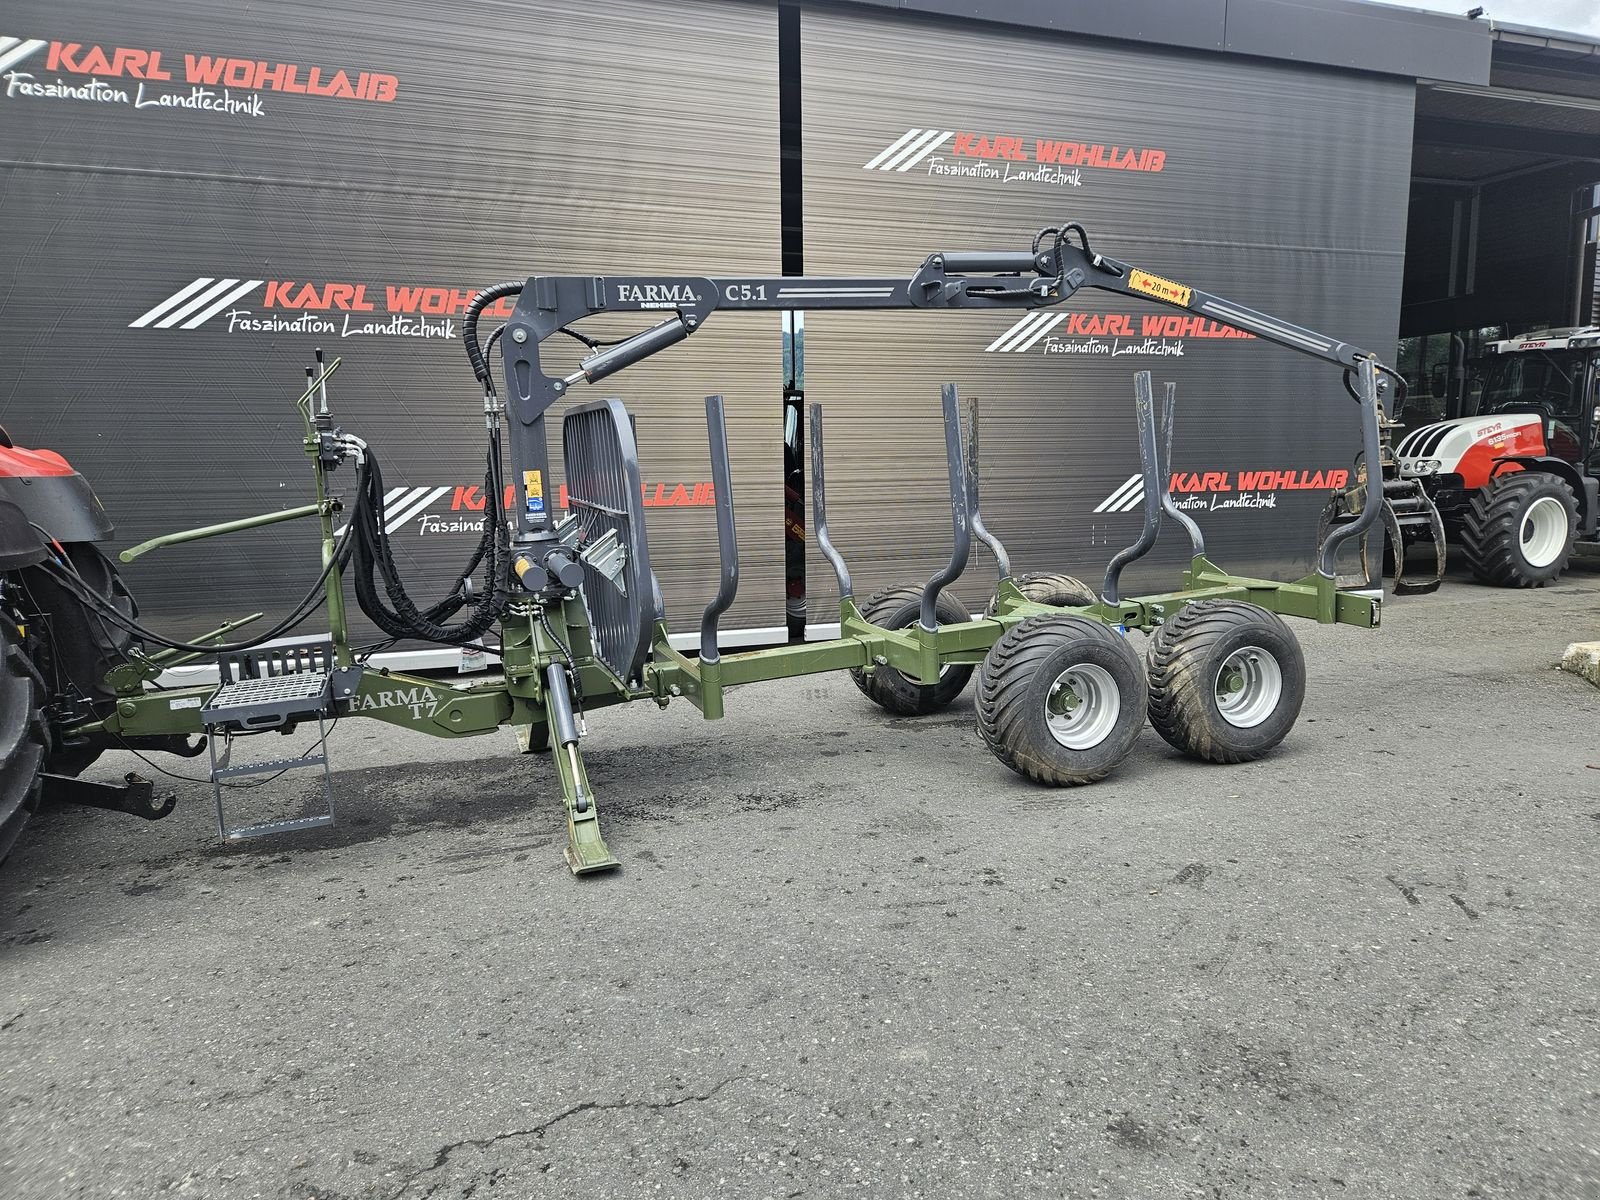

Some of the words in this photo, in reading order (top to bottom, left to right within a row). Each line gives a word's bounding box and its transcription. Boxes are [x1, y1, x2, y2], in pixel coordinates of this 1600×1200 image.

[47, 41, 171, 81] KARL
[3, 71, 129, 103] Faszination
[134, 82, 265, 117] Landtechnik
[952, 132, 1028, 161] KARL
[927, 156, 999, 180] Faszination
[1003, 162, 1082, 187] Landtechnik
[264, 280, 375, 312] KARL
[1152, 281, 1162, 292] 20
[1161, 287, 1169, 296] m
[225, 308, 336, 334] Faszination
[341, 314, 457, 340] Landtechnik
[1066, 312, 1135, 337] KARL
[1043, 335, 1109, 356] Faszination
[1112, 337, 1185, 358] Landtechnik
[1518, 341, 1547, 350] STEYR
[1476, 422, 1502, 437] STEYR
[1168, 471, 1233, 494] KARL
[1209, 492, 1277, 512] Landtechnik
[407, 700, 439, 720] T7
